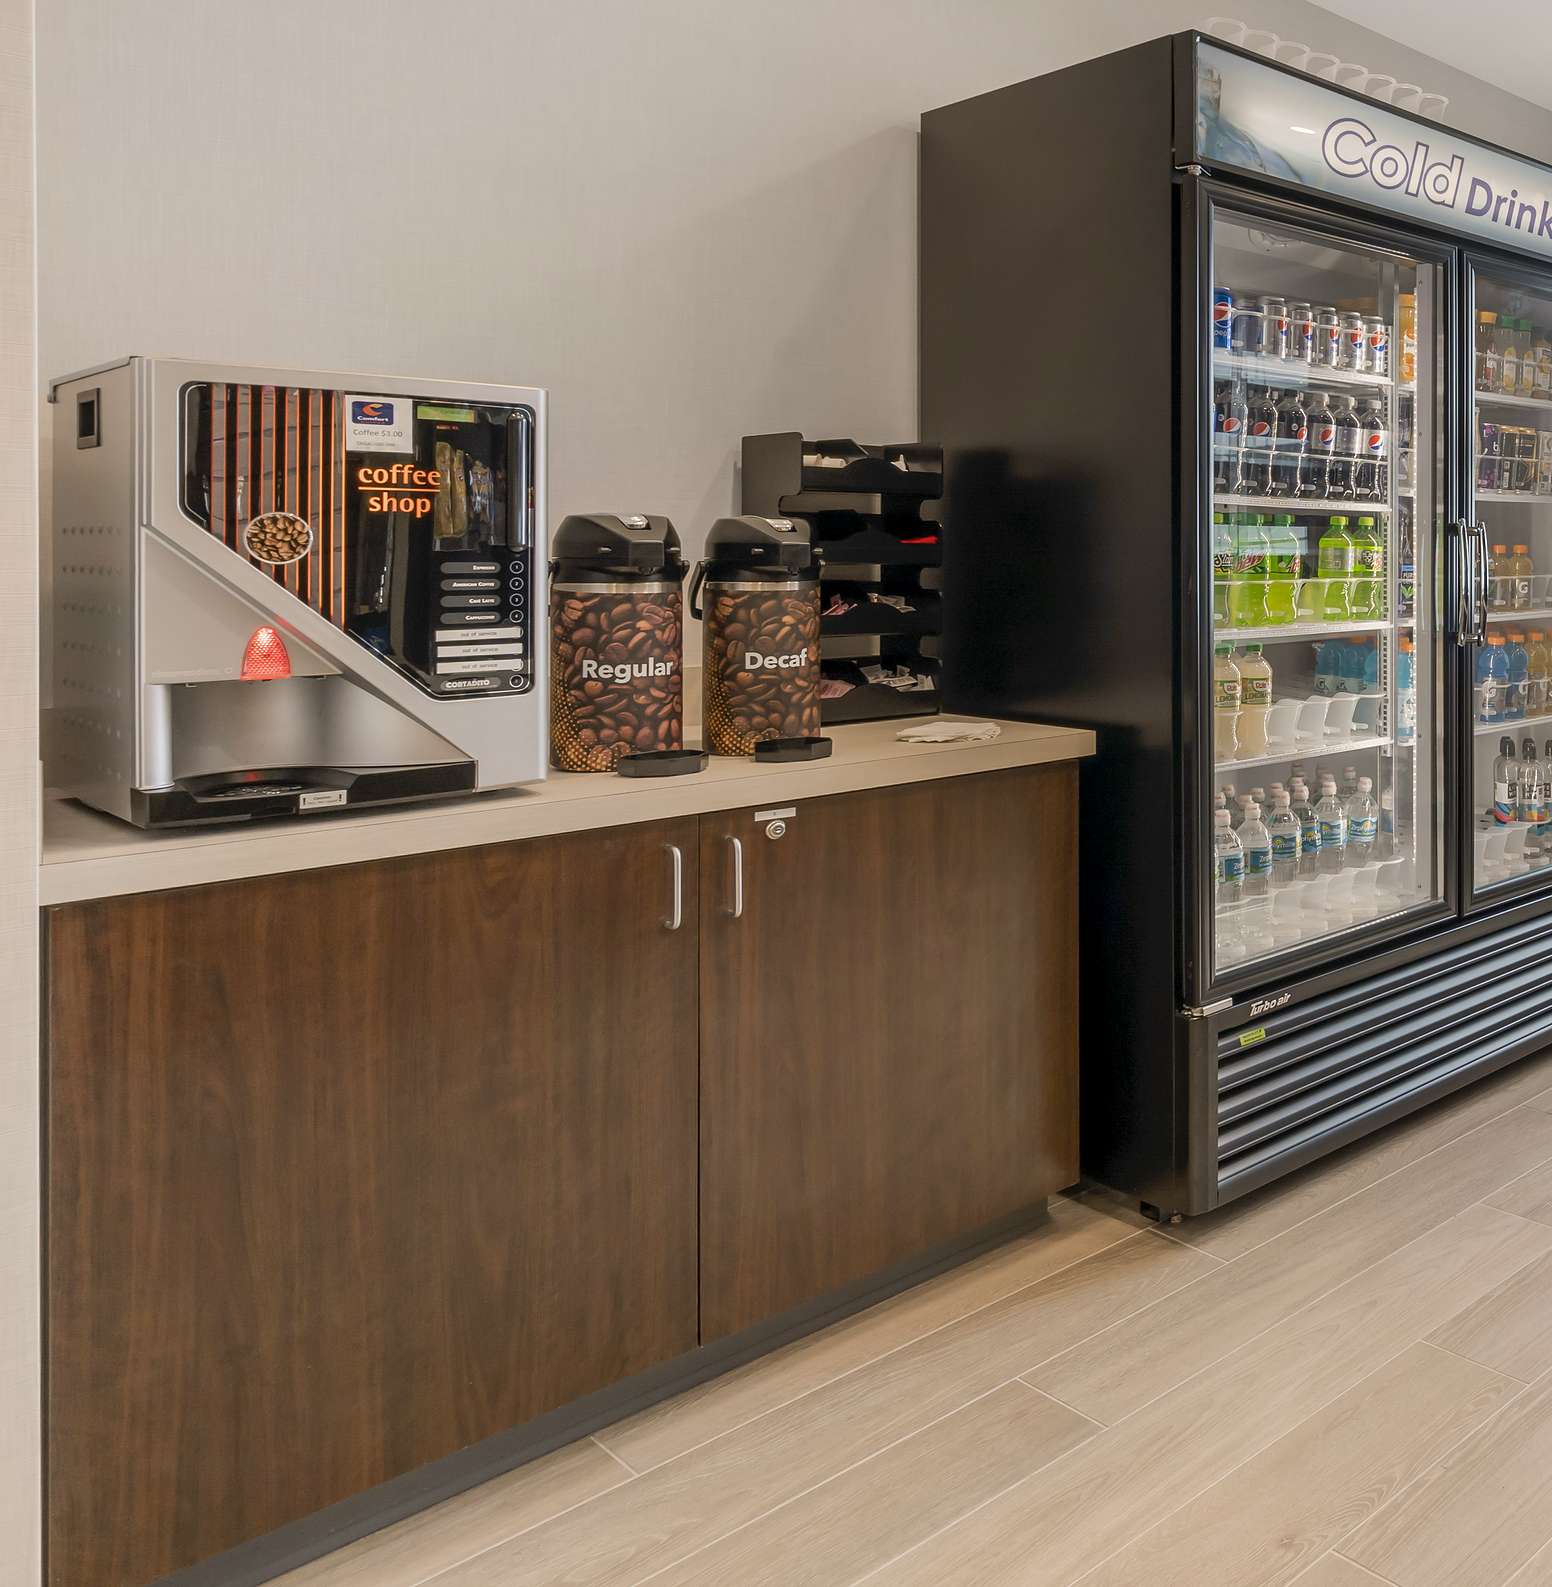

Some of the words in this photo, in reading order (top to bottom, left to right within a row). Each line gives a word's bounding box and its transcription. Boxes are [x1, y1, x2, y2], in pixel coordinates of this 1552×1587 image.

[1321, 117, 1465, 209] Cold
[353, 429, 381, 437] Coffee
[358, 463, 441, 486] coffee
[368, 491, 432, 519] shop
[581, 657, 673, 684] Regular
[744, 648, 808, 670] Decaf
